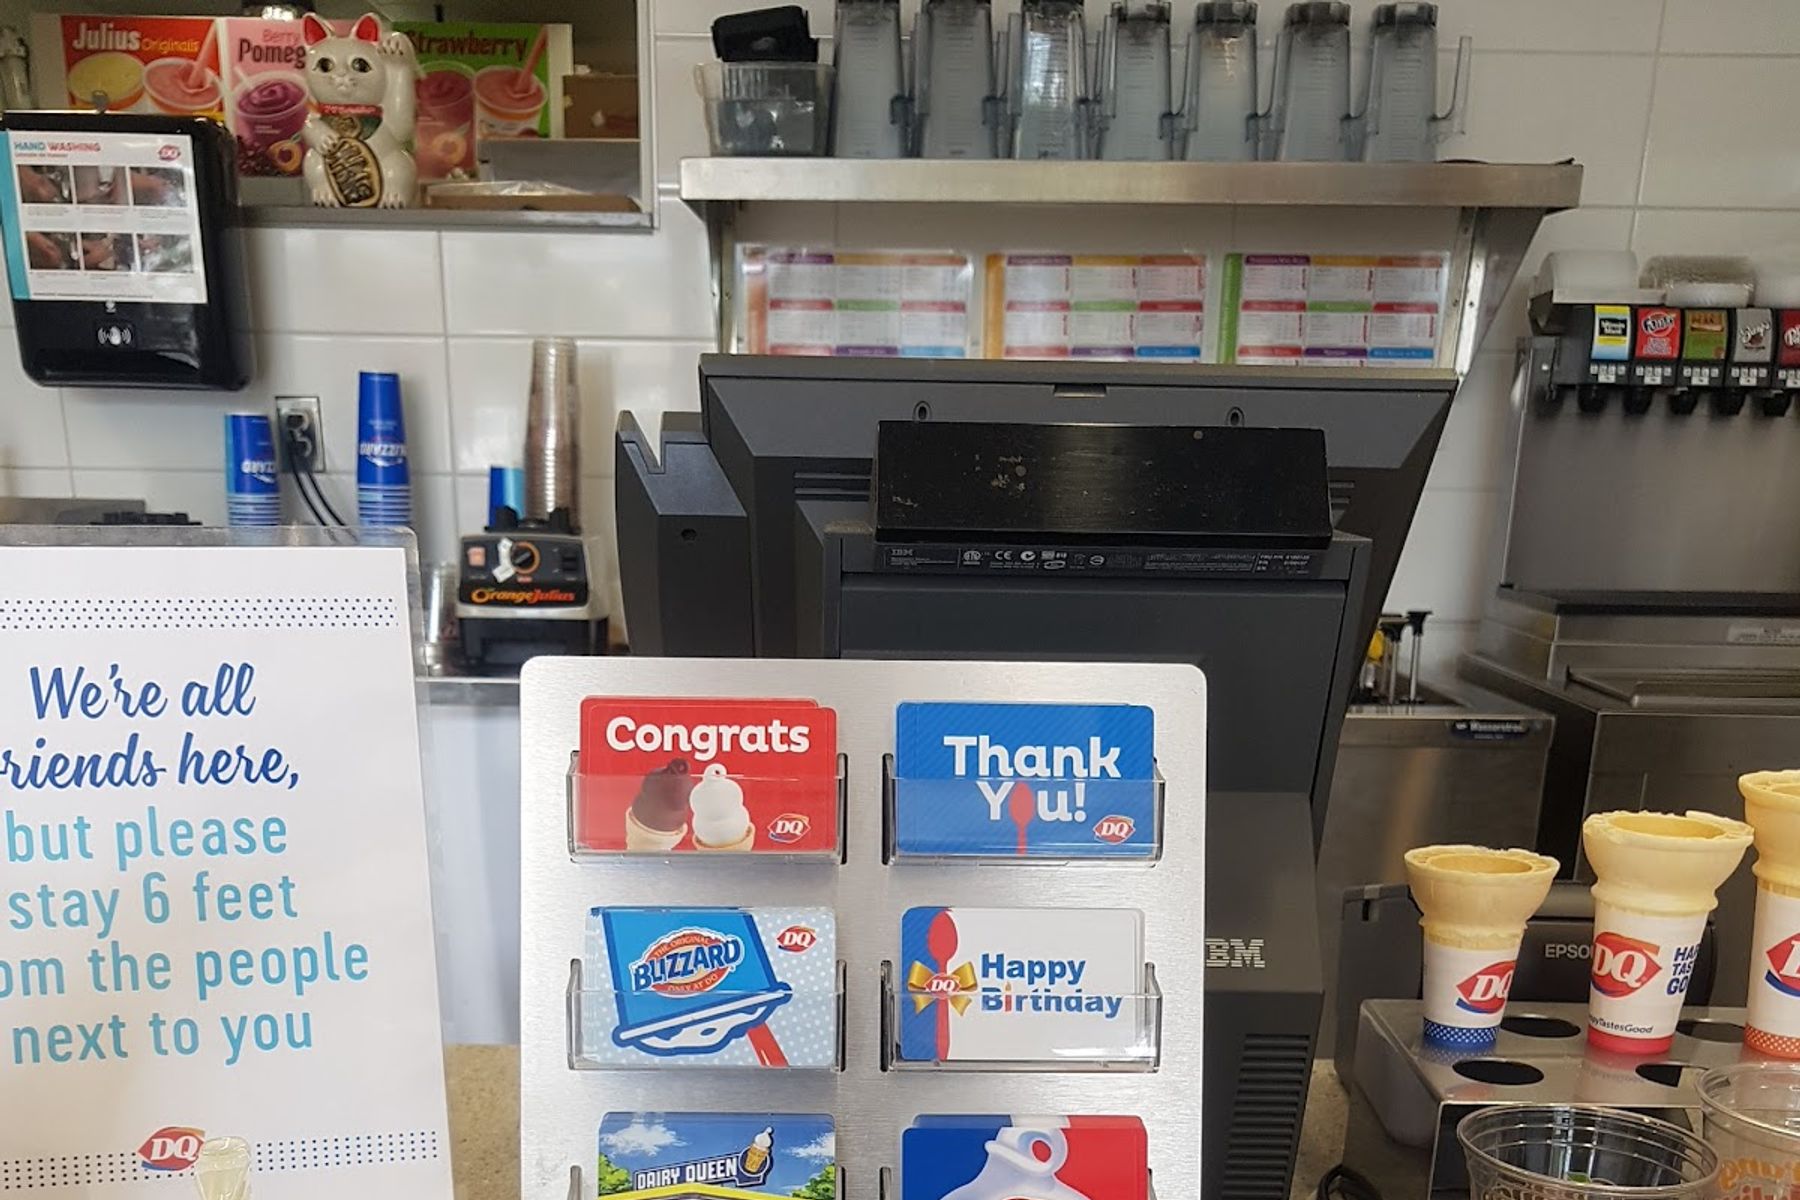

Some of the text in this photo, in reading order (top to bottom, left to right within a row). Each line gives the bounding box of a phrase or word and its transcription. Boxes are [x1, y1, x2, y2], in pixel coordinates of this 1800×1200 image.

[72, 21, 142, 51] Julius
[238, 38, 306, 69] Pomeg
[14, 142, 101, 152] HAND WASHING
[29, 662, 256, 719] We're all
[605, 716, 811, 761] Congrats
[943, 735, 1122, 778] Thank
[0, 732, 299, 789] riends here,
[6, 806, 287, 871] but please
[9, 871, 298, 939] stay 6 feet
[88, 940, 171, 992] the
[196, 931, 369, 1000] people
[633, 939, 742, 992] BLIZZARD
[981, 954, 1086, 985] Happy
[1204, 939, 1265, 968] BM
[1545, 943, 1594, 959] EPSO
[1593, 942, 1648, 989] DQ
[692, 981, 704, 990] AT
[981, 984, 1123, 1019] Birthday
[13, 1012, 312, 1065] next to you
[150, 1135, 201, 1162] DQ
[637, 1156, 738, 1189] DAIRY QUEEN
